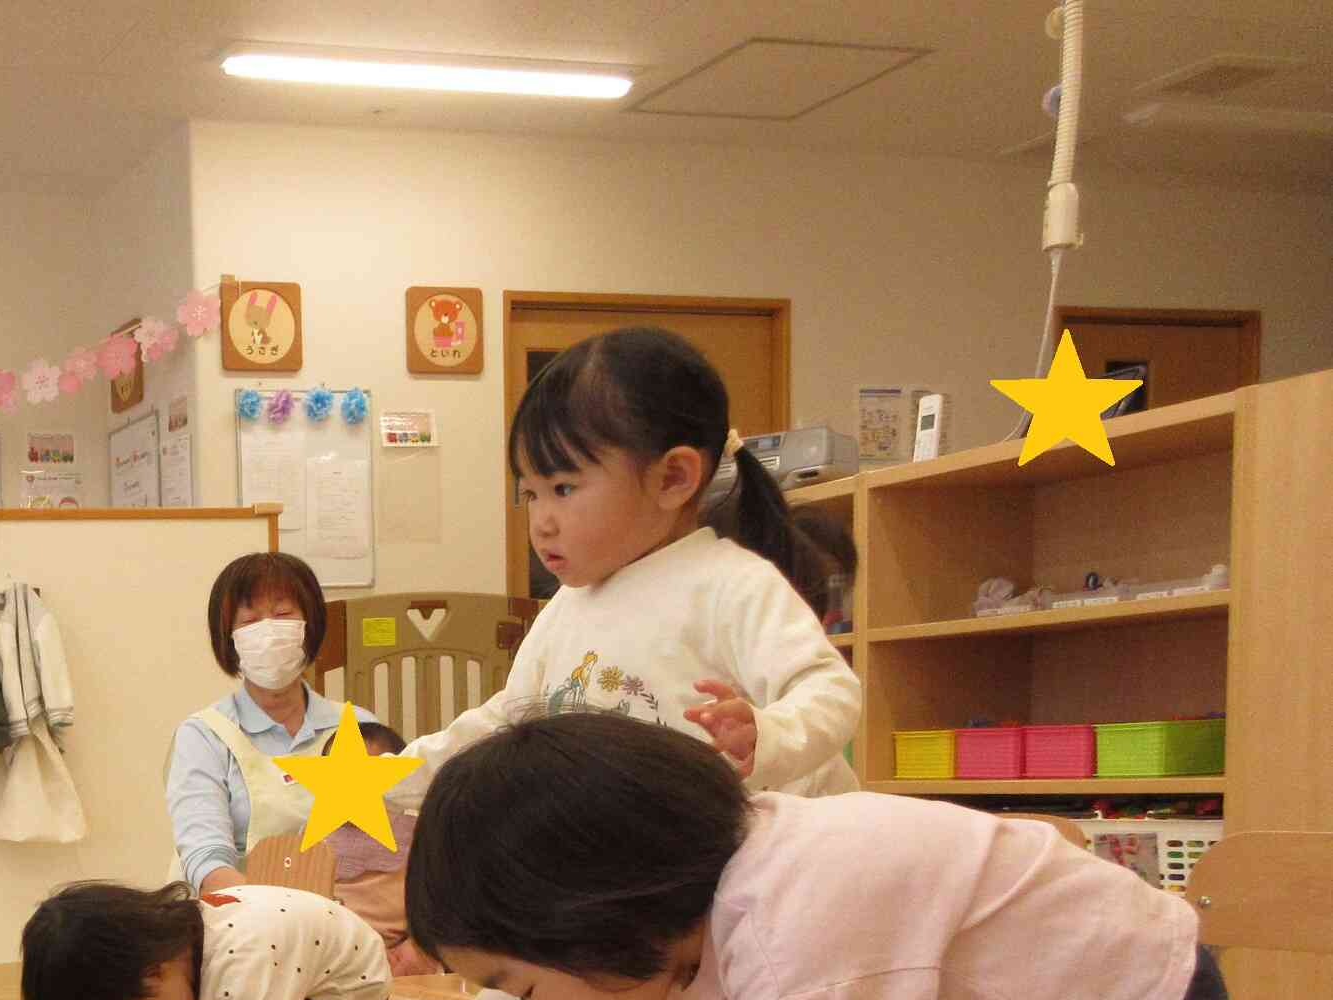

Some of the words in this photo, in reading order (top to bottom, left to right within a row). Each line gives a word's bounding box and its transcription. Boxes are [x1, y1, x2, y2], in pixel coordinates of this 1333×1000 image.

[244, 344, 280, 356] うさぎ
[430, 348, 462, 359] といれ
